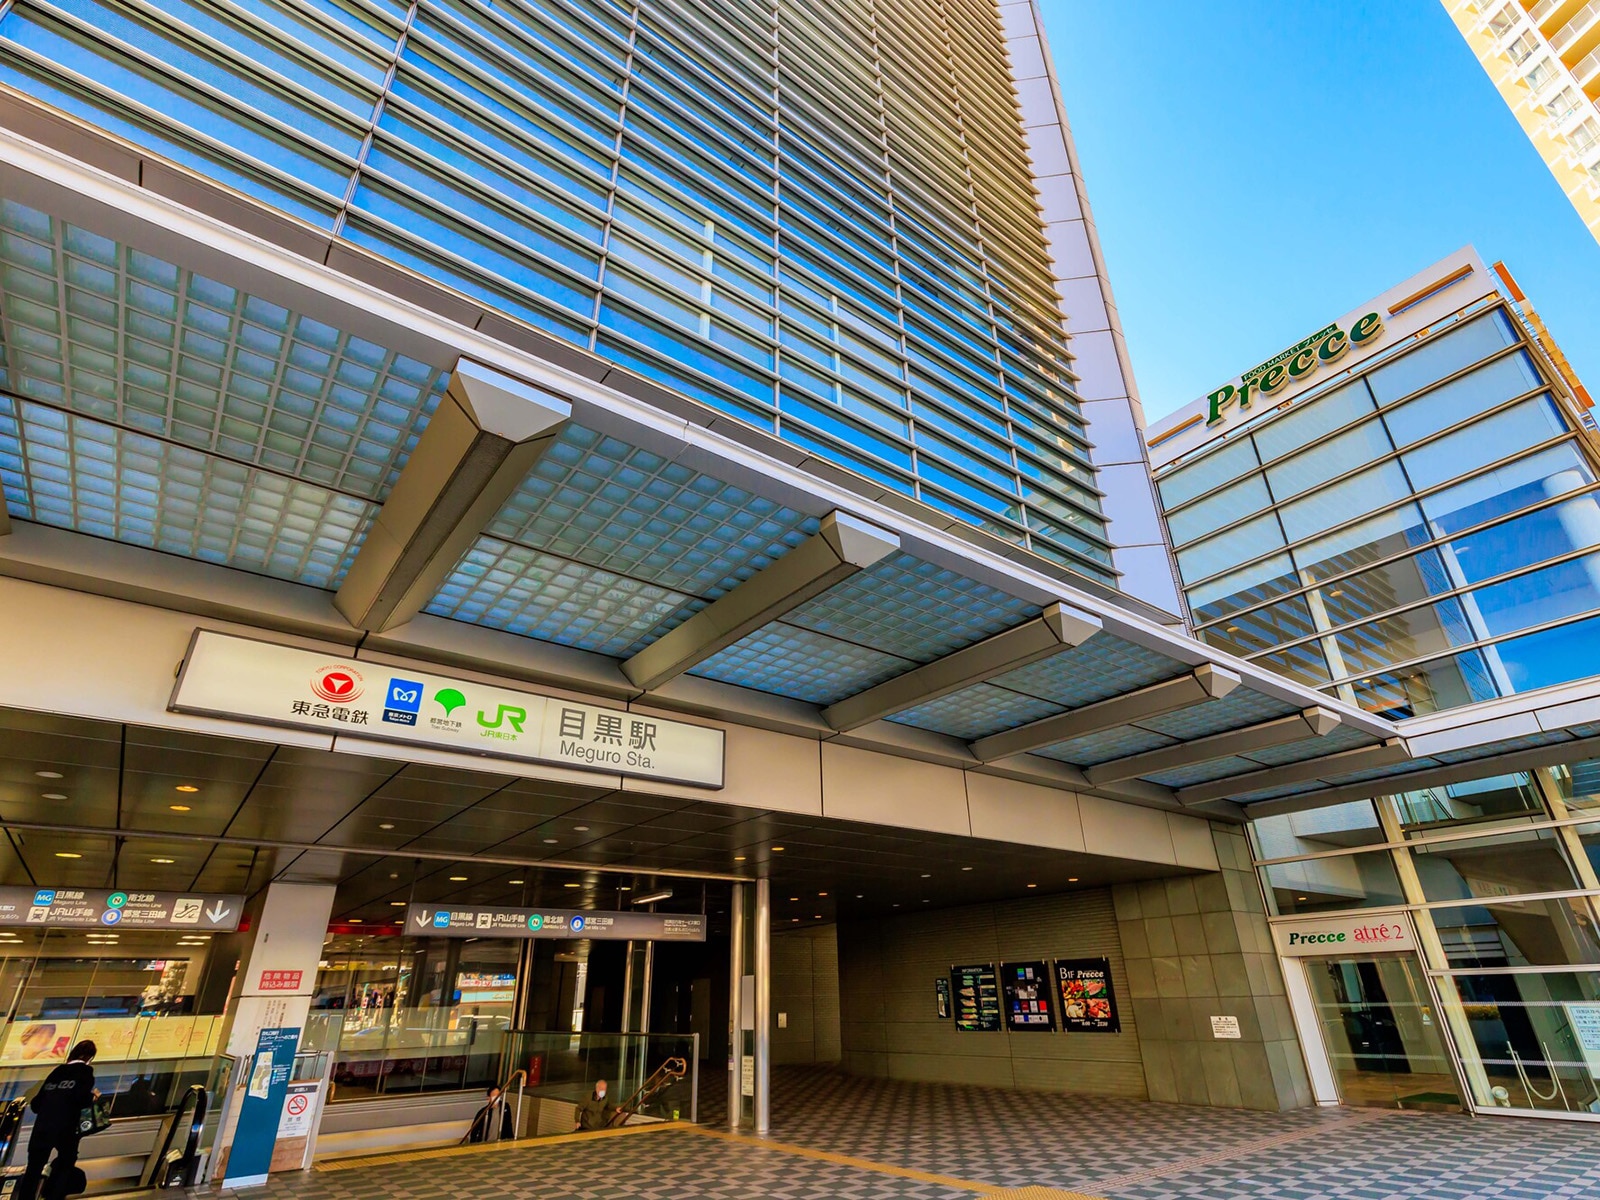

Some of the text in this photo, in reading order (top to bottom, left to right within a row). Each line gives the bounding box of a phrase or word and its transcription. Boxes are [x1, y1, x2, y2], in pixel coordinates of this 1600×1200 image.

[1303, 325, 1335, 347] プレッセ
[1243, 345, 1301, 381] FOOD MARKET
[1206, 311, 1385, 426] Precce
[290, 699, 370, 725] 東急電鉄
[430, 717, 462, 728] 都営地下鉄
[476, 703, 527, 733] JR
[559, 708, 657, 751] 目黒駅
[480, 729, 518, 741] JR東日本
[560, 739, 655, 769] Meguro Sta.
[55, 891, 85, 900] 目黒線
[128, 893, 155, 902] 南北線
[49, 908, 94, 917] JR山手線
[122, 910, 167, 919] 都営三田線
[450, 912, 474, 921] 目黒線
[435, 915, 448, 924] MG
[492, 913, 526, 923] JR山手線
[543, 915, 564, 924] 南北線
[585, 917, 614, 925] 都営三田線
[1289, 923, 1405, 945] Precce atré 2
[1077, 970, 1105, 979] Precce
